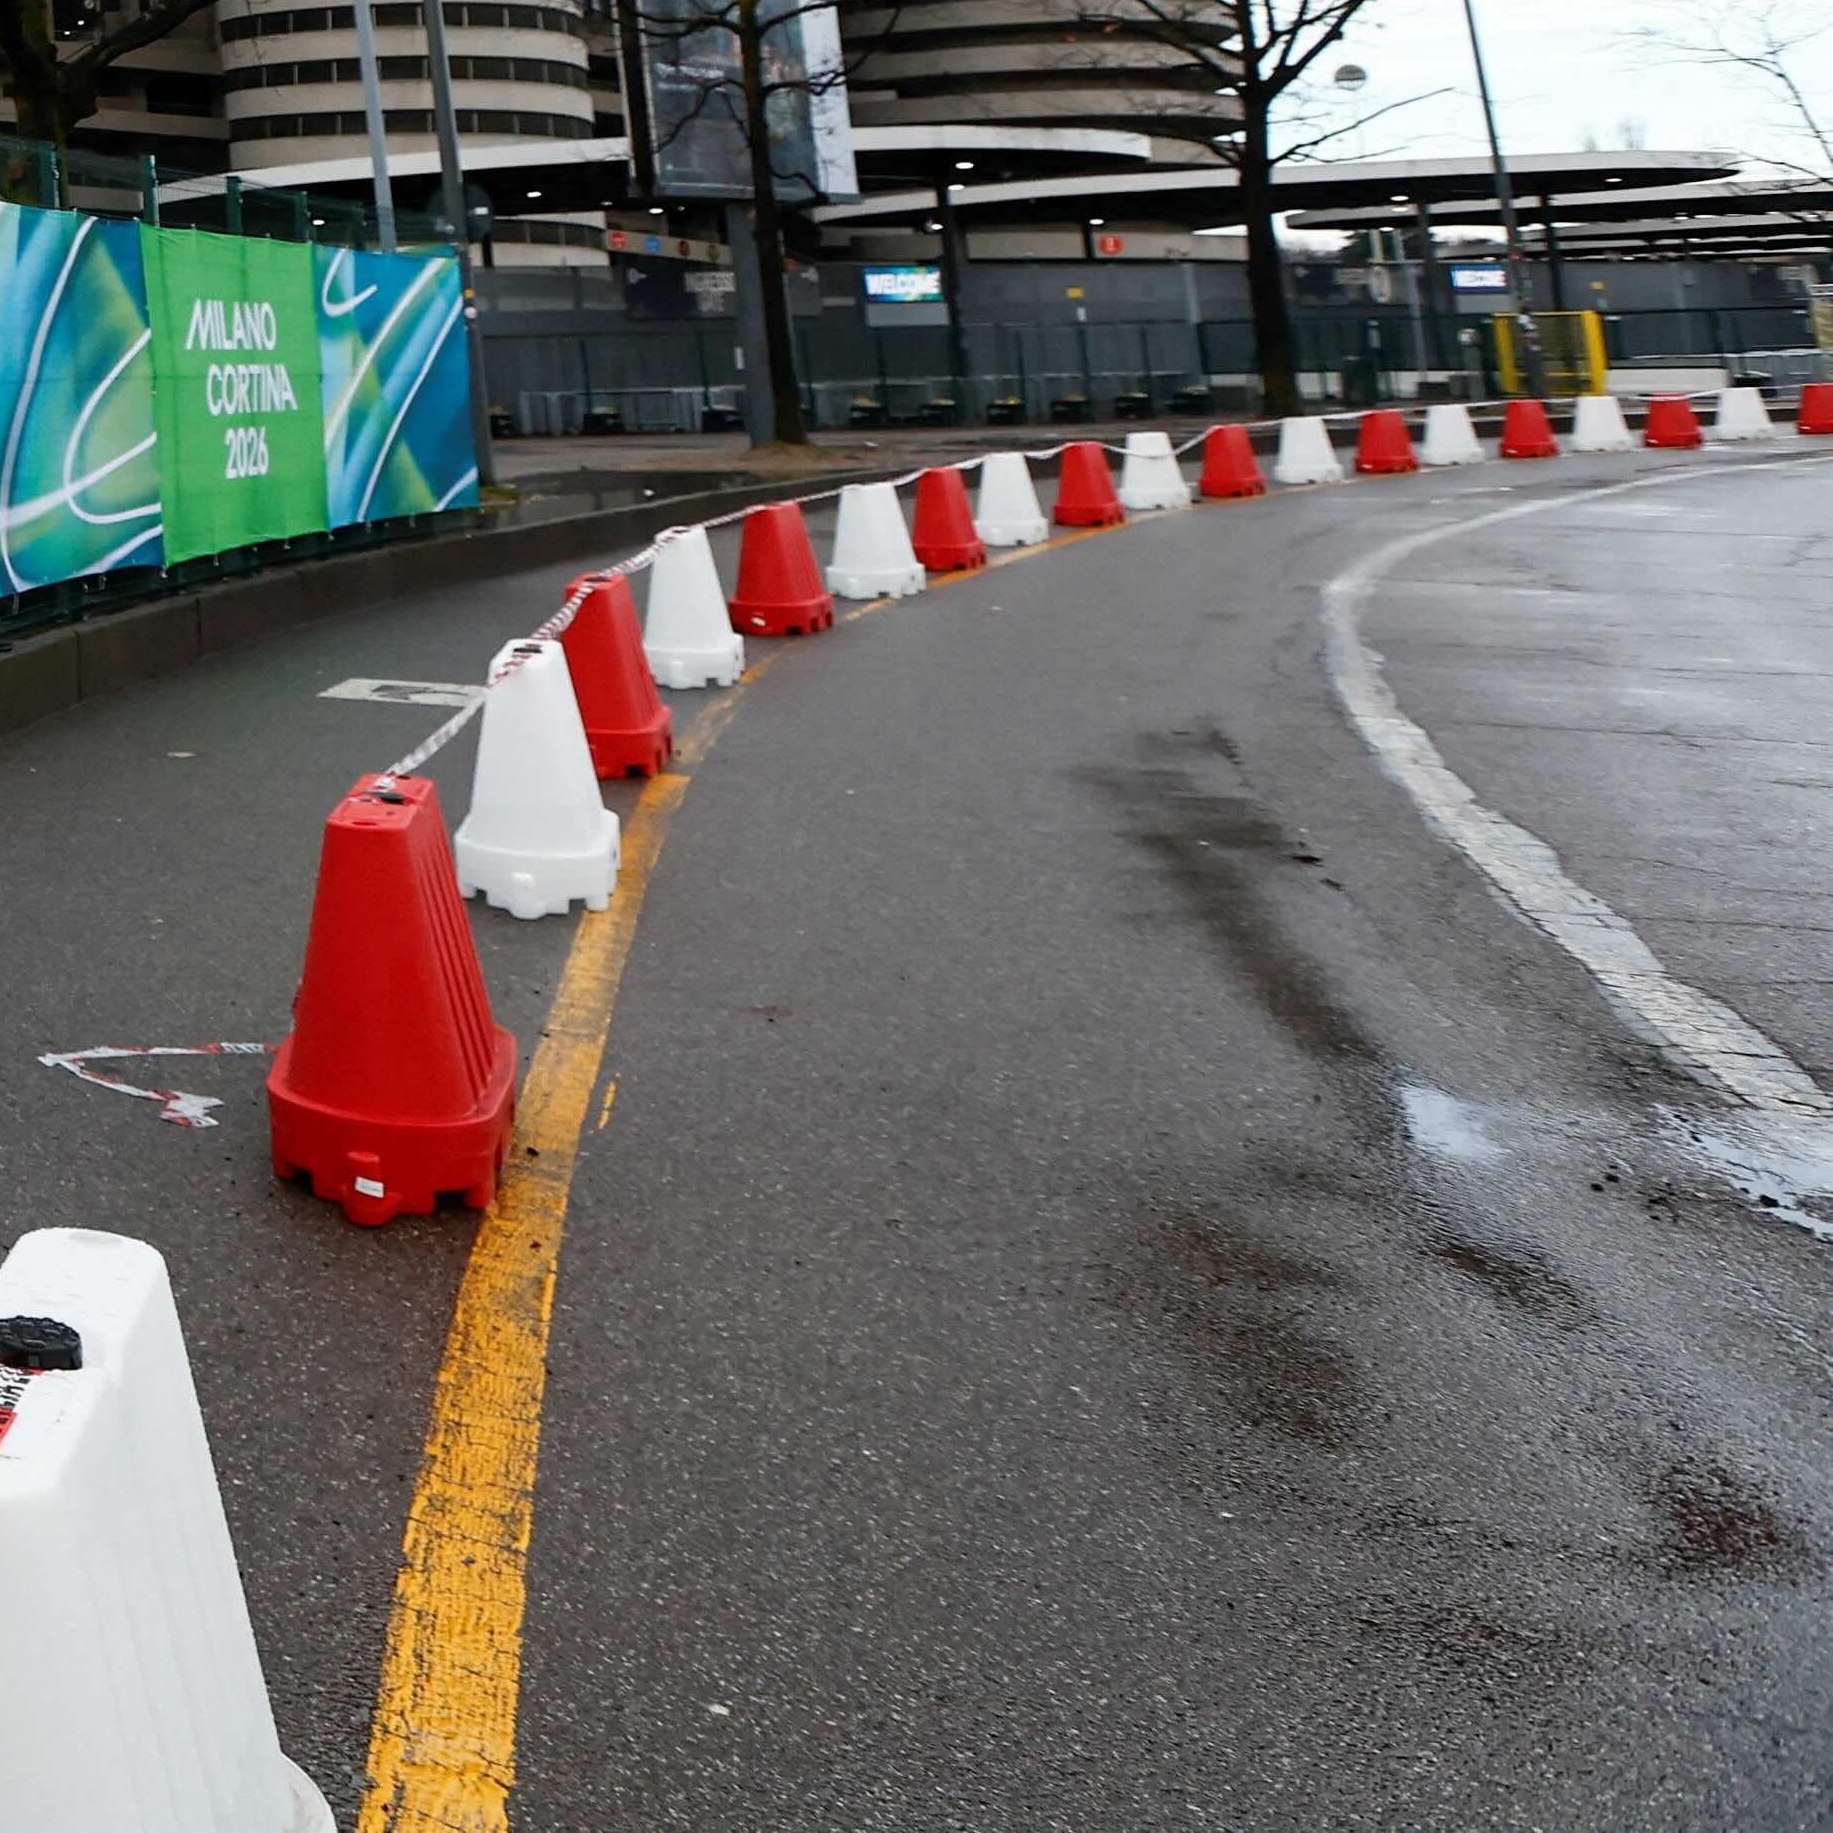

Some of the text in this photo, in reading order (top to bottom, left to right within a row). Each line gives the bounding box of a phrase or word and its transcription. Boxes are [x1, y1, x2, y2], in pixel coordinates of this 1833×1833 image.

[185, 298, 276, 351] MILANO
[206, 363, 297, 416] CORTINA
[224, 427, 269, 479] 2026
